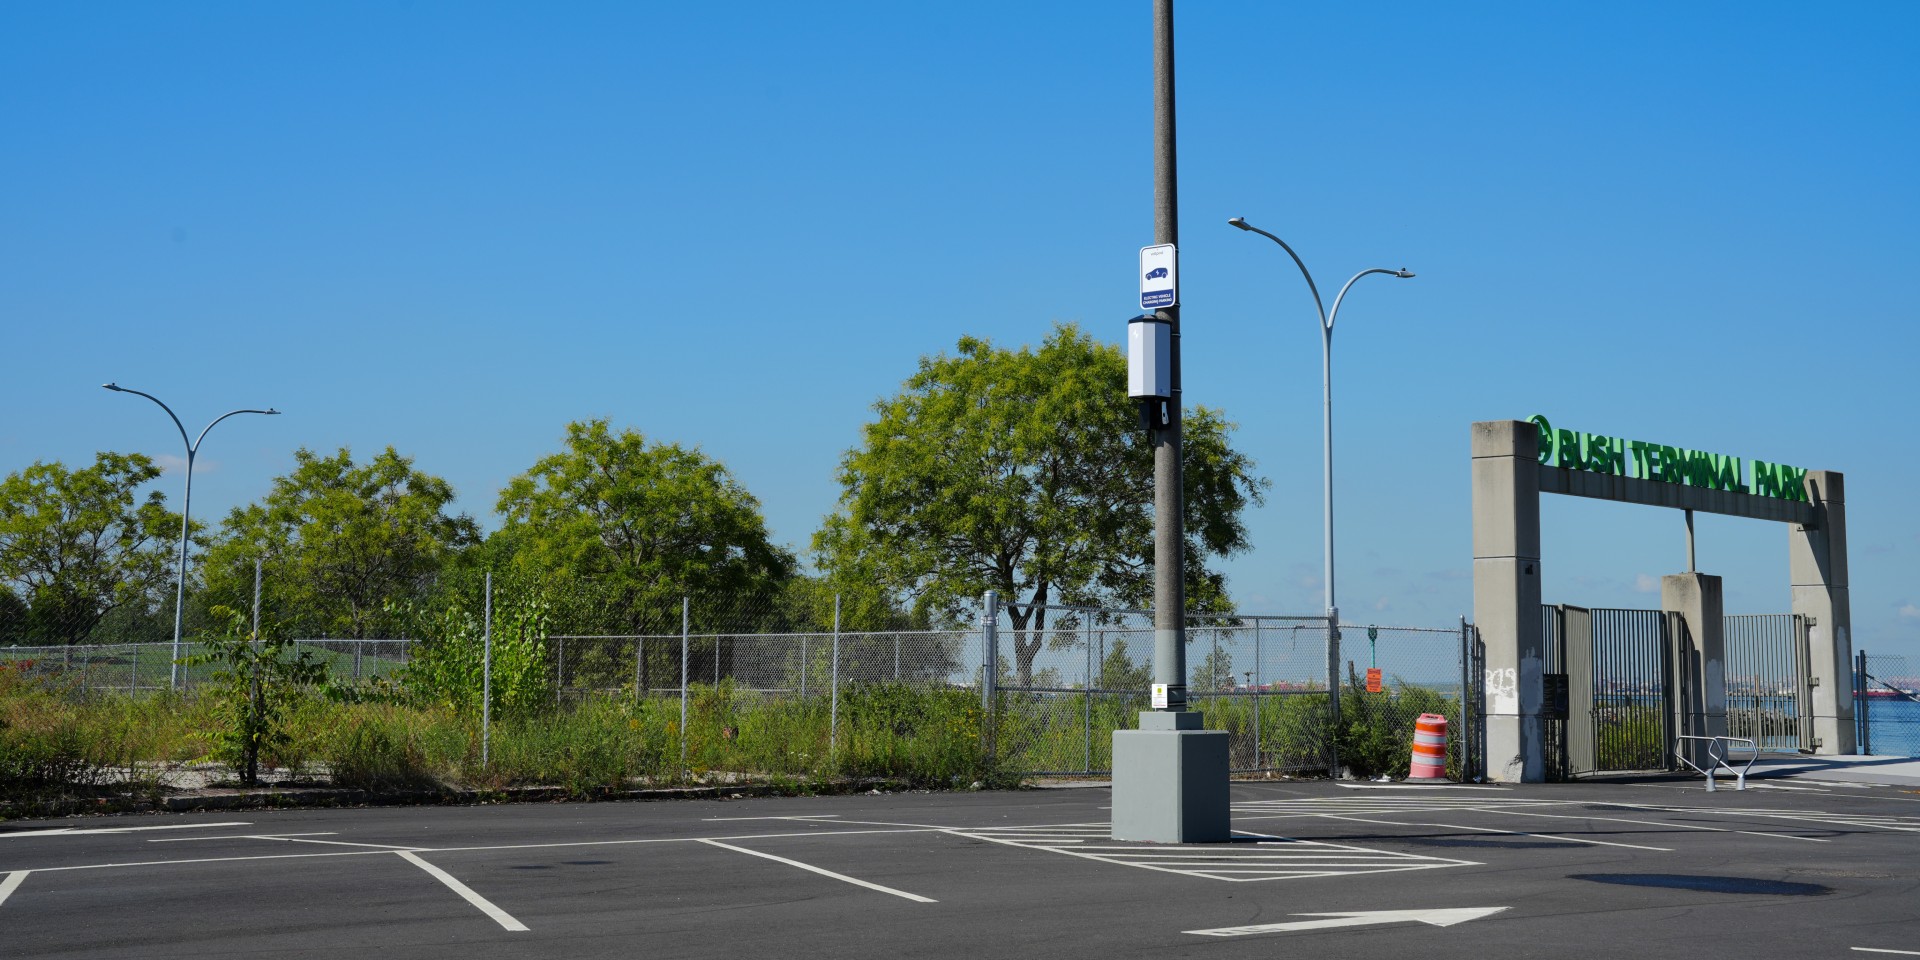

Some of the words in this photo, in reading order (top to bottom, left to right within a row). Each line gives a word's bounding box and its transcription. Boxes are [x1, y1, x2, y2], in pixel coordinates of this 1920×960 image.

[1553, 428, 1625, 476] BUSH
[1627, 440, 1749, 494] TERMINAL
[1749, 459, 1808, 502] PARK
